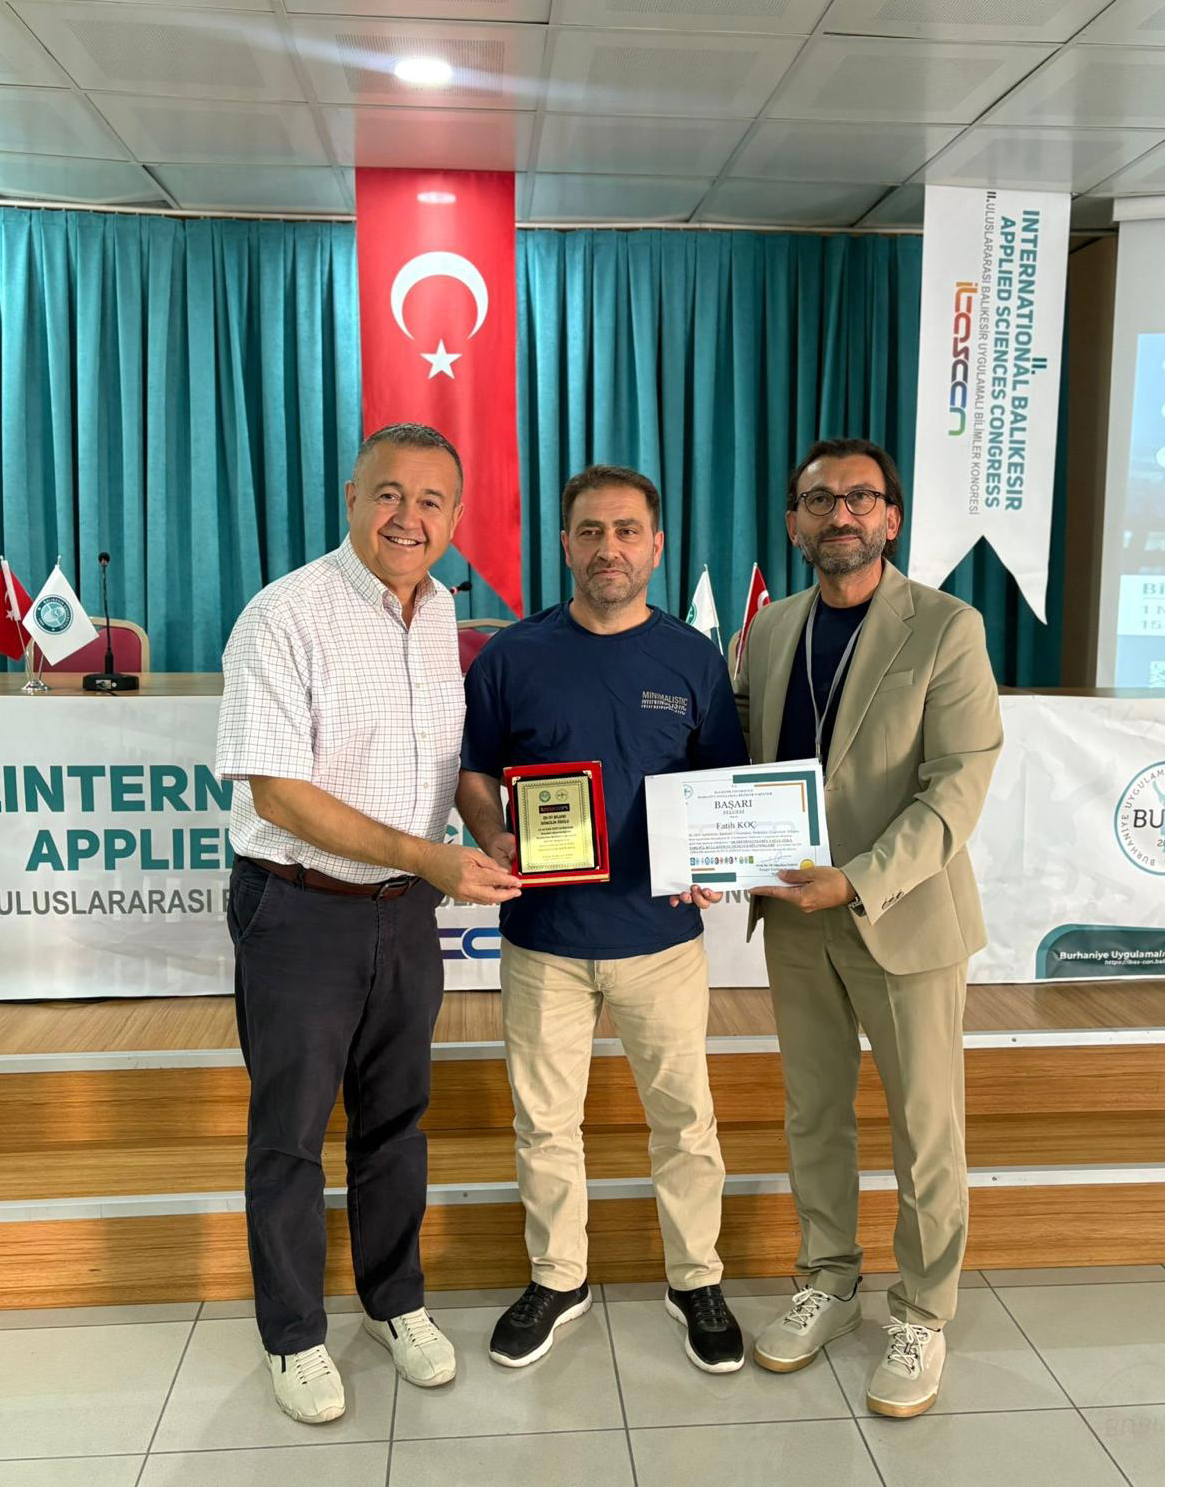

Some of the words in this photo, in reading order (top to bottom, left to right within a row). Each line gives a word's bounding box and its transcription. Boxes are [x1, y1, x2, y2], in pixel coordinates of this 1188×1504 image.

[997, 216, 1016, 300] APPLIED
[1012, 210, 1040, 391] INTERNATIONAL
[975, 343, 988, 409] UYGULAMALI
[991, 306, 1010, 399] SCIENCES
[1032, 357, 1047, 375] II.
[971, 412, 984, 459] BİLİMLER
[985, 405, 1004, 508] CONGRESS
[1005, 397, 1029, 510] BALIKESIR
[642, 691, 687, 705] MINIMALISTIC
[714, 800, 752, 809] BAŞARI
[737, 821, 757, 829] KOÇ
[1060, 951, 1109, 960] Burhaniye
